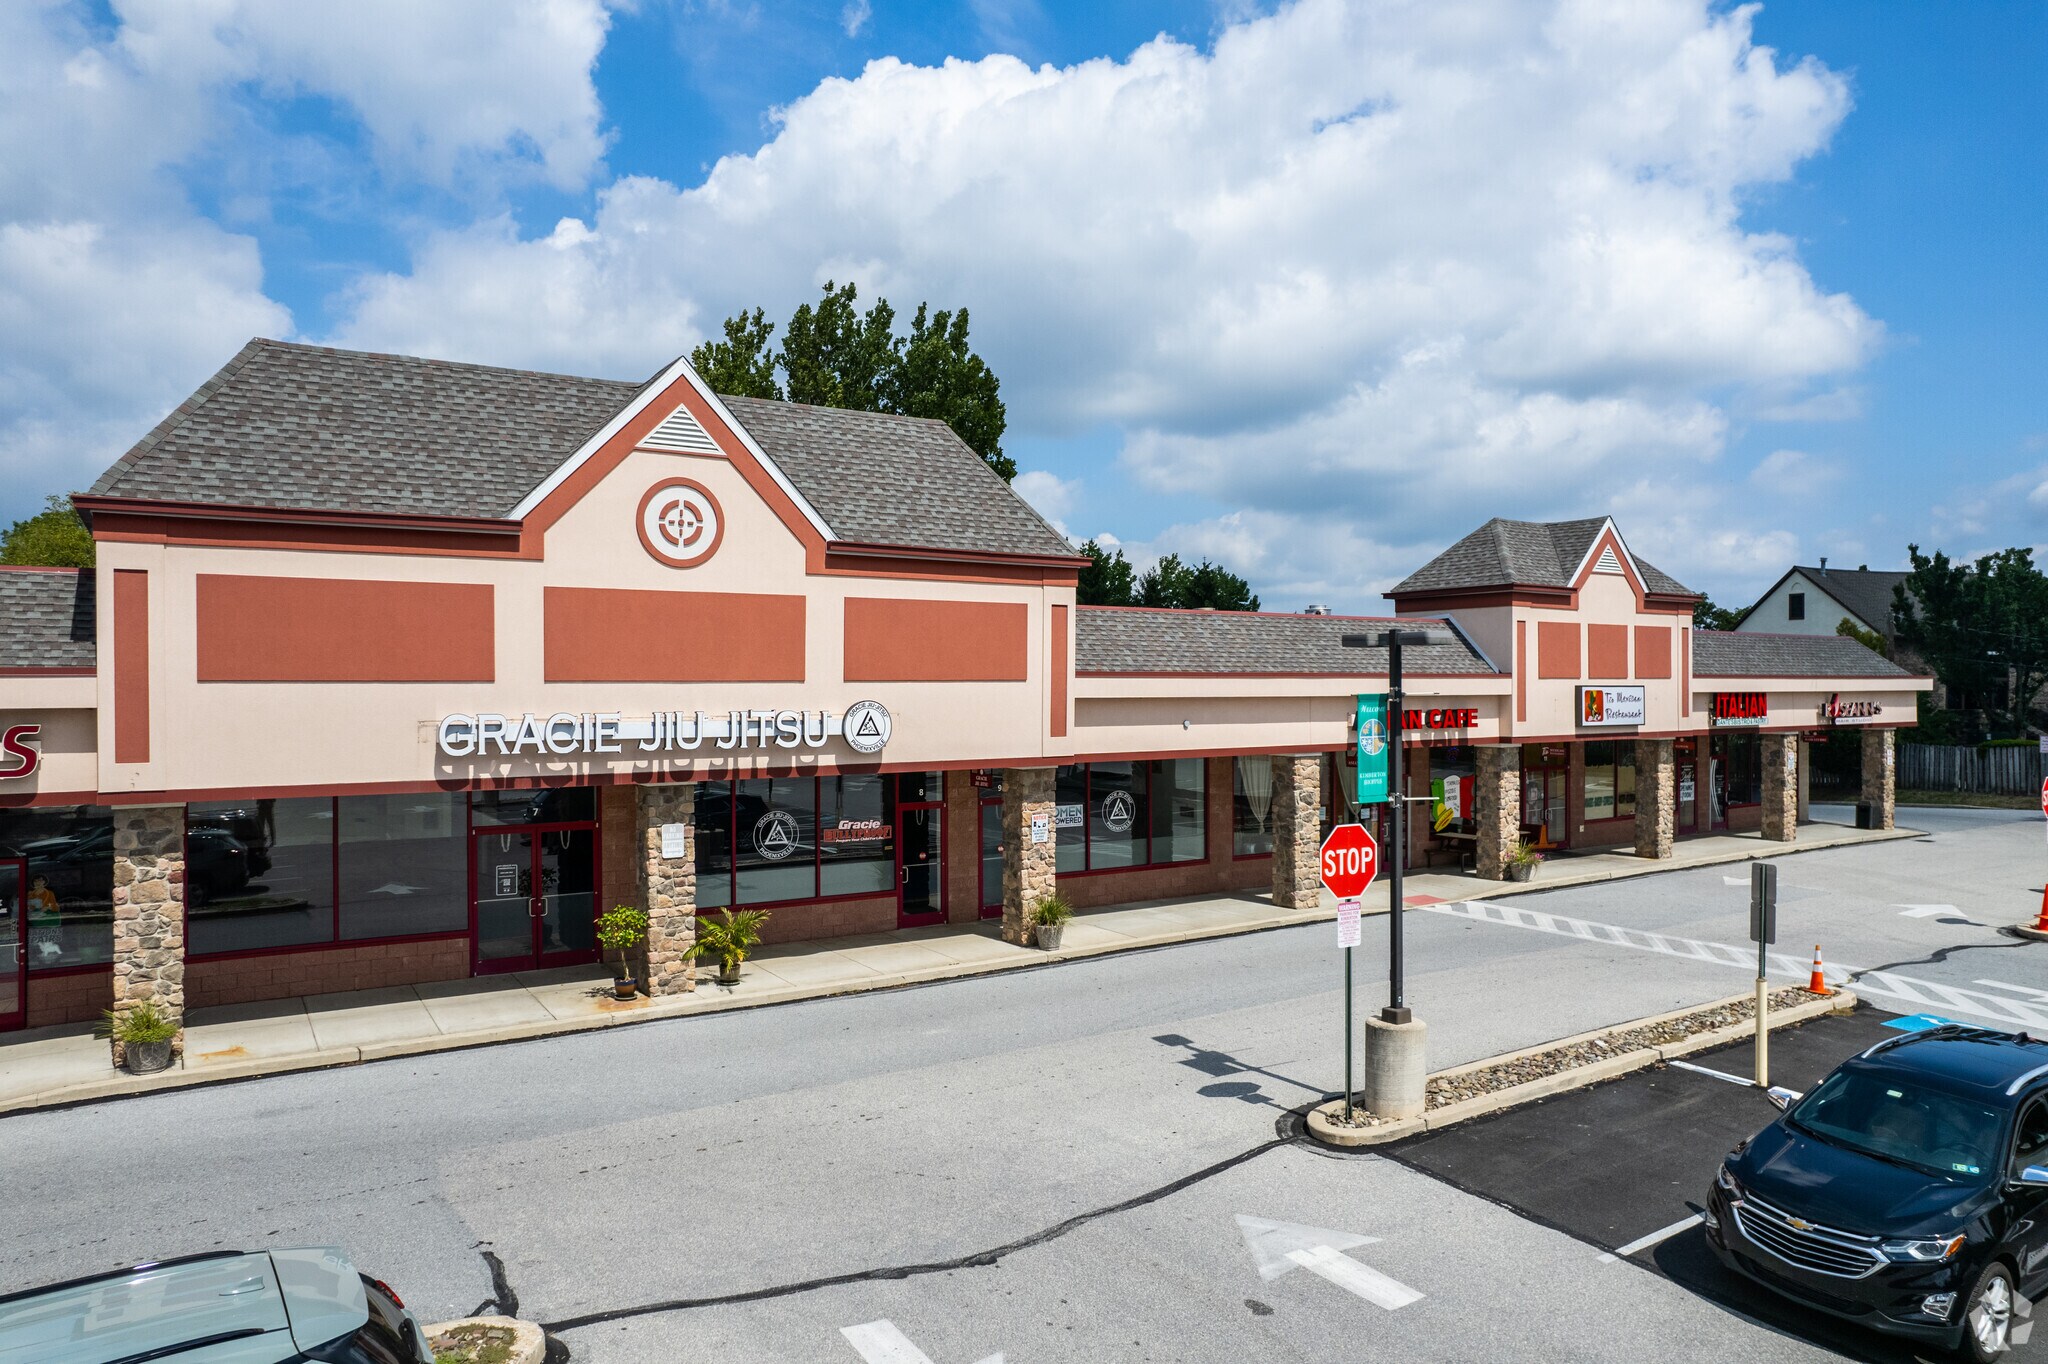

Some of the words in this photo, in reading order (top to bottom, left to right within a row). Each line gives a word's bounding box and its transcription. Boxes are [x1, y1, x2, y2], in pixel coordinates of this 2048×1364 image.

[1716, 692, 1767, 718] ITALIAN
[1429, 708, 1478, 729] CAFE
[438, 711, 622, 757] GRACIE
[639, 711, 704, 751] JIU
[716, 710, 829, 749] JITSU
[919, 788, 924, 796] 8
[533, 807, 539, 816] 7
[1056, 806, 1082, 818] OMEN
[838, 819, 881, 830] Gracie
[1056, 816, 1082, 825] OWERED
[1324, 846, 1373, 877] STOP
